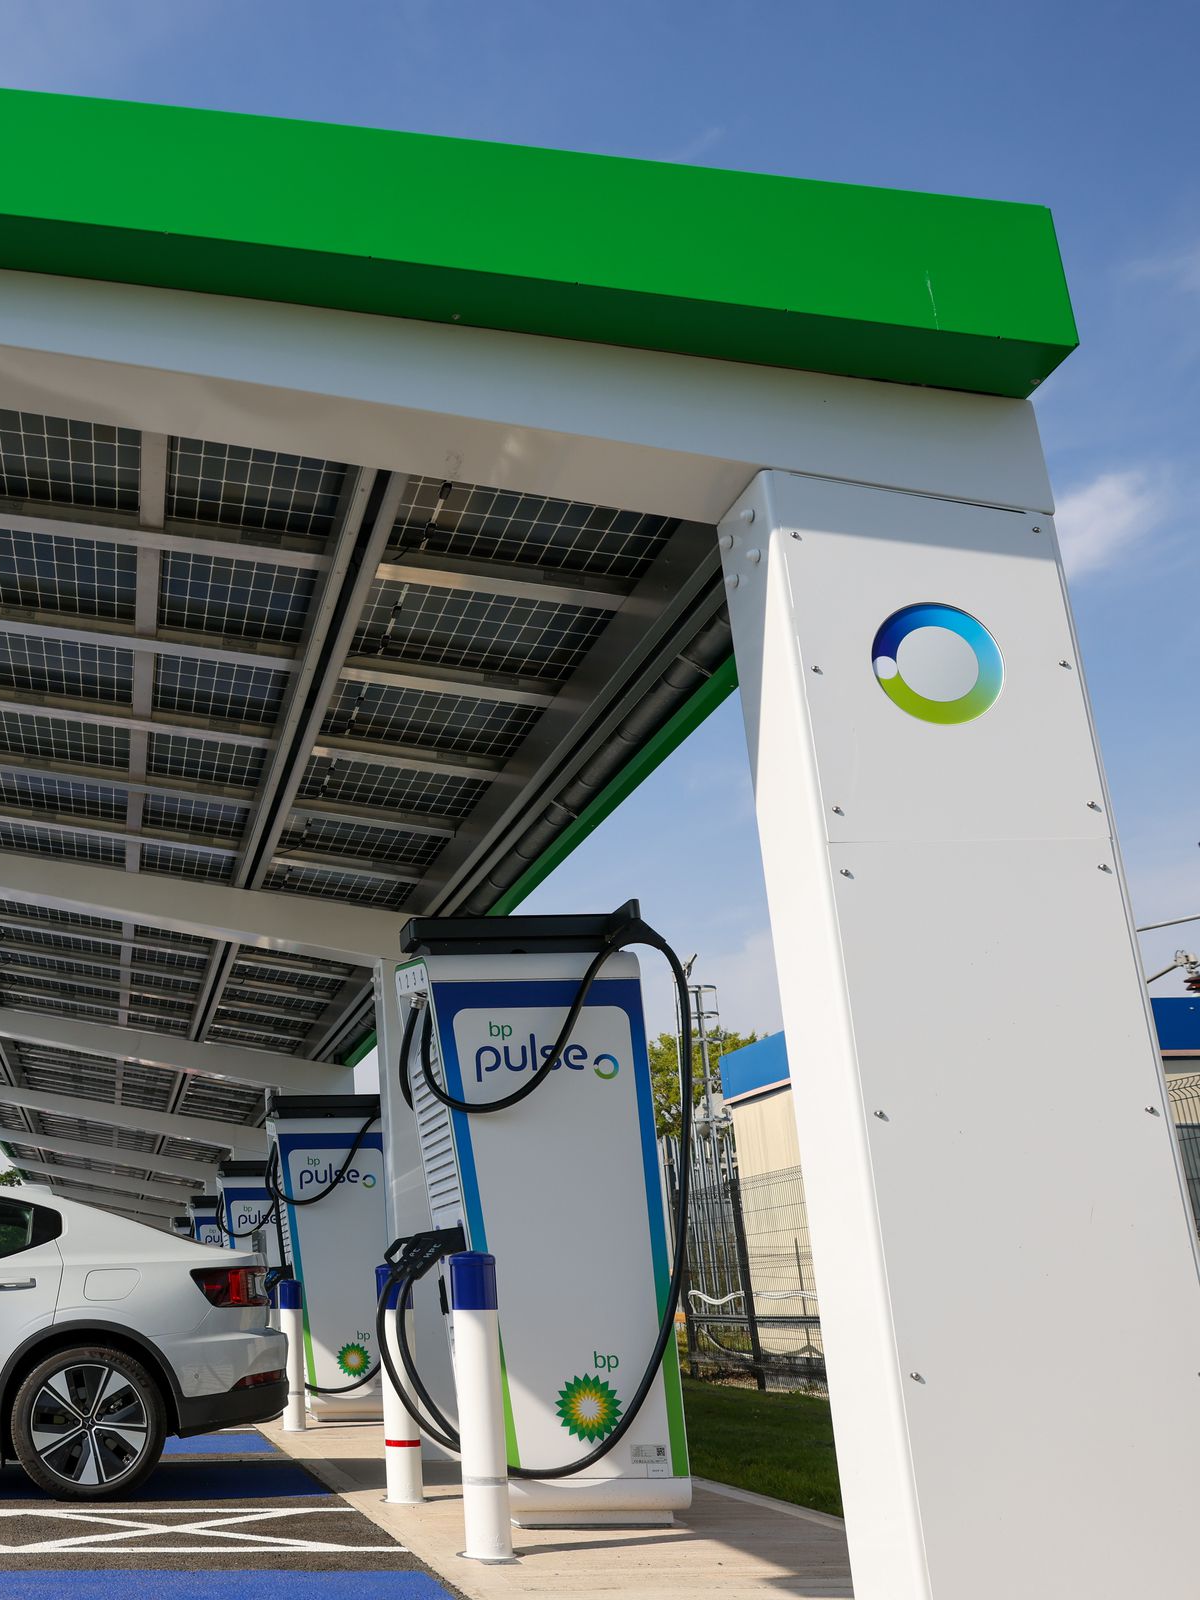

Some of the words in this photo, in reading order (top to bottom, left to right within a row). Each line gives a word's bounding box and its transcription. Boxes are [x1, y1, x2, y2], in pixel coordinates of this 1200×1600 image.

[488, 1021, 513, 1040] bp
[475, 1033, 588, 1082] pulse
[307, 1156, 321, 1168] bp
[300, 1163, 360, 1190] pulse
[243, 1205, 253, 1213] bp
[356, 1330, 371, 1342] bp
[593, 1351, 619, 1373] bp
